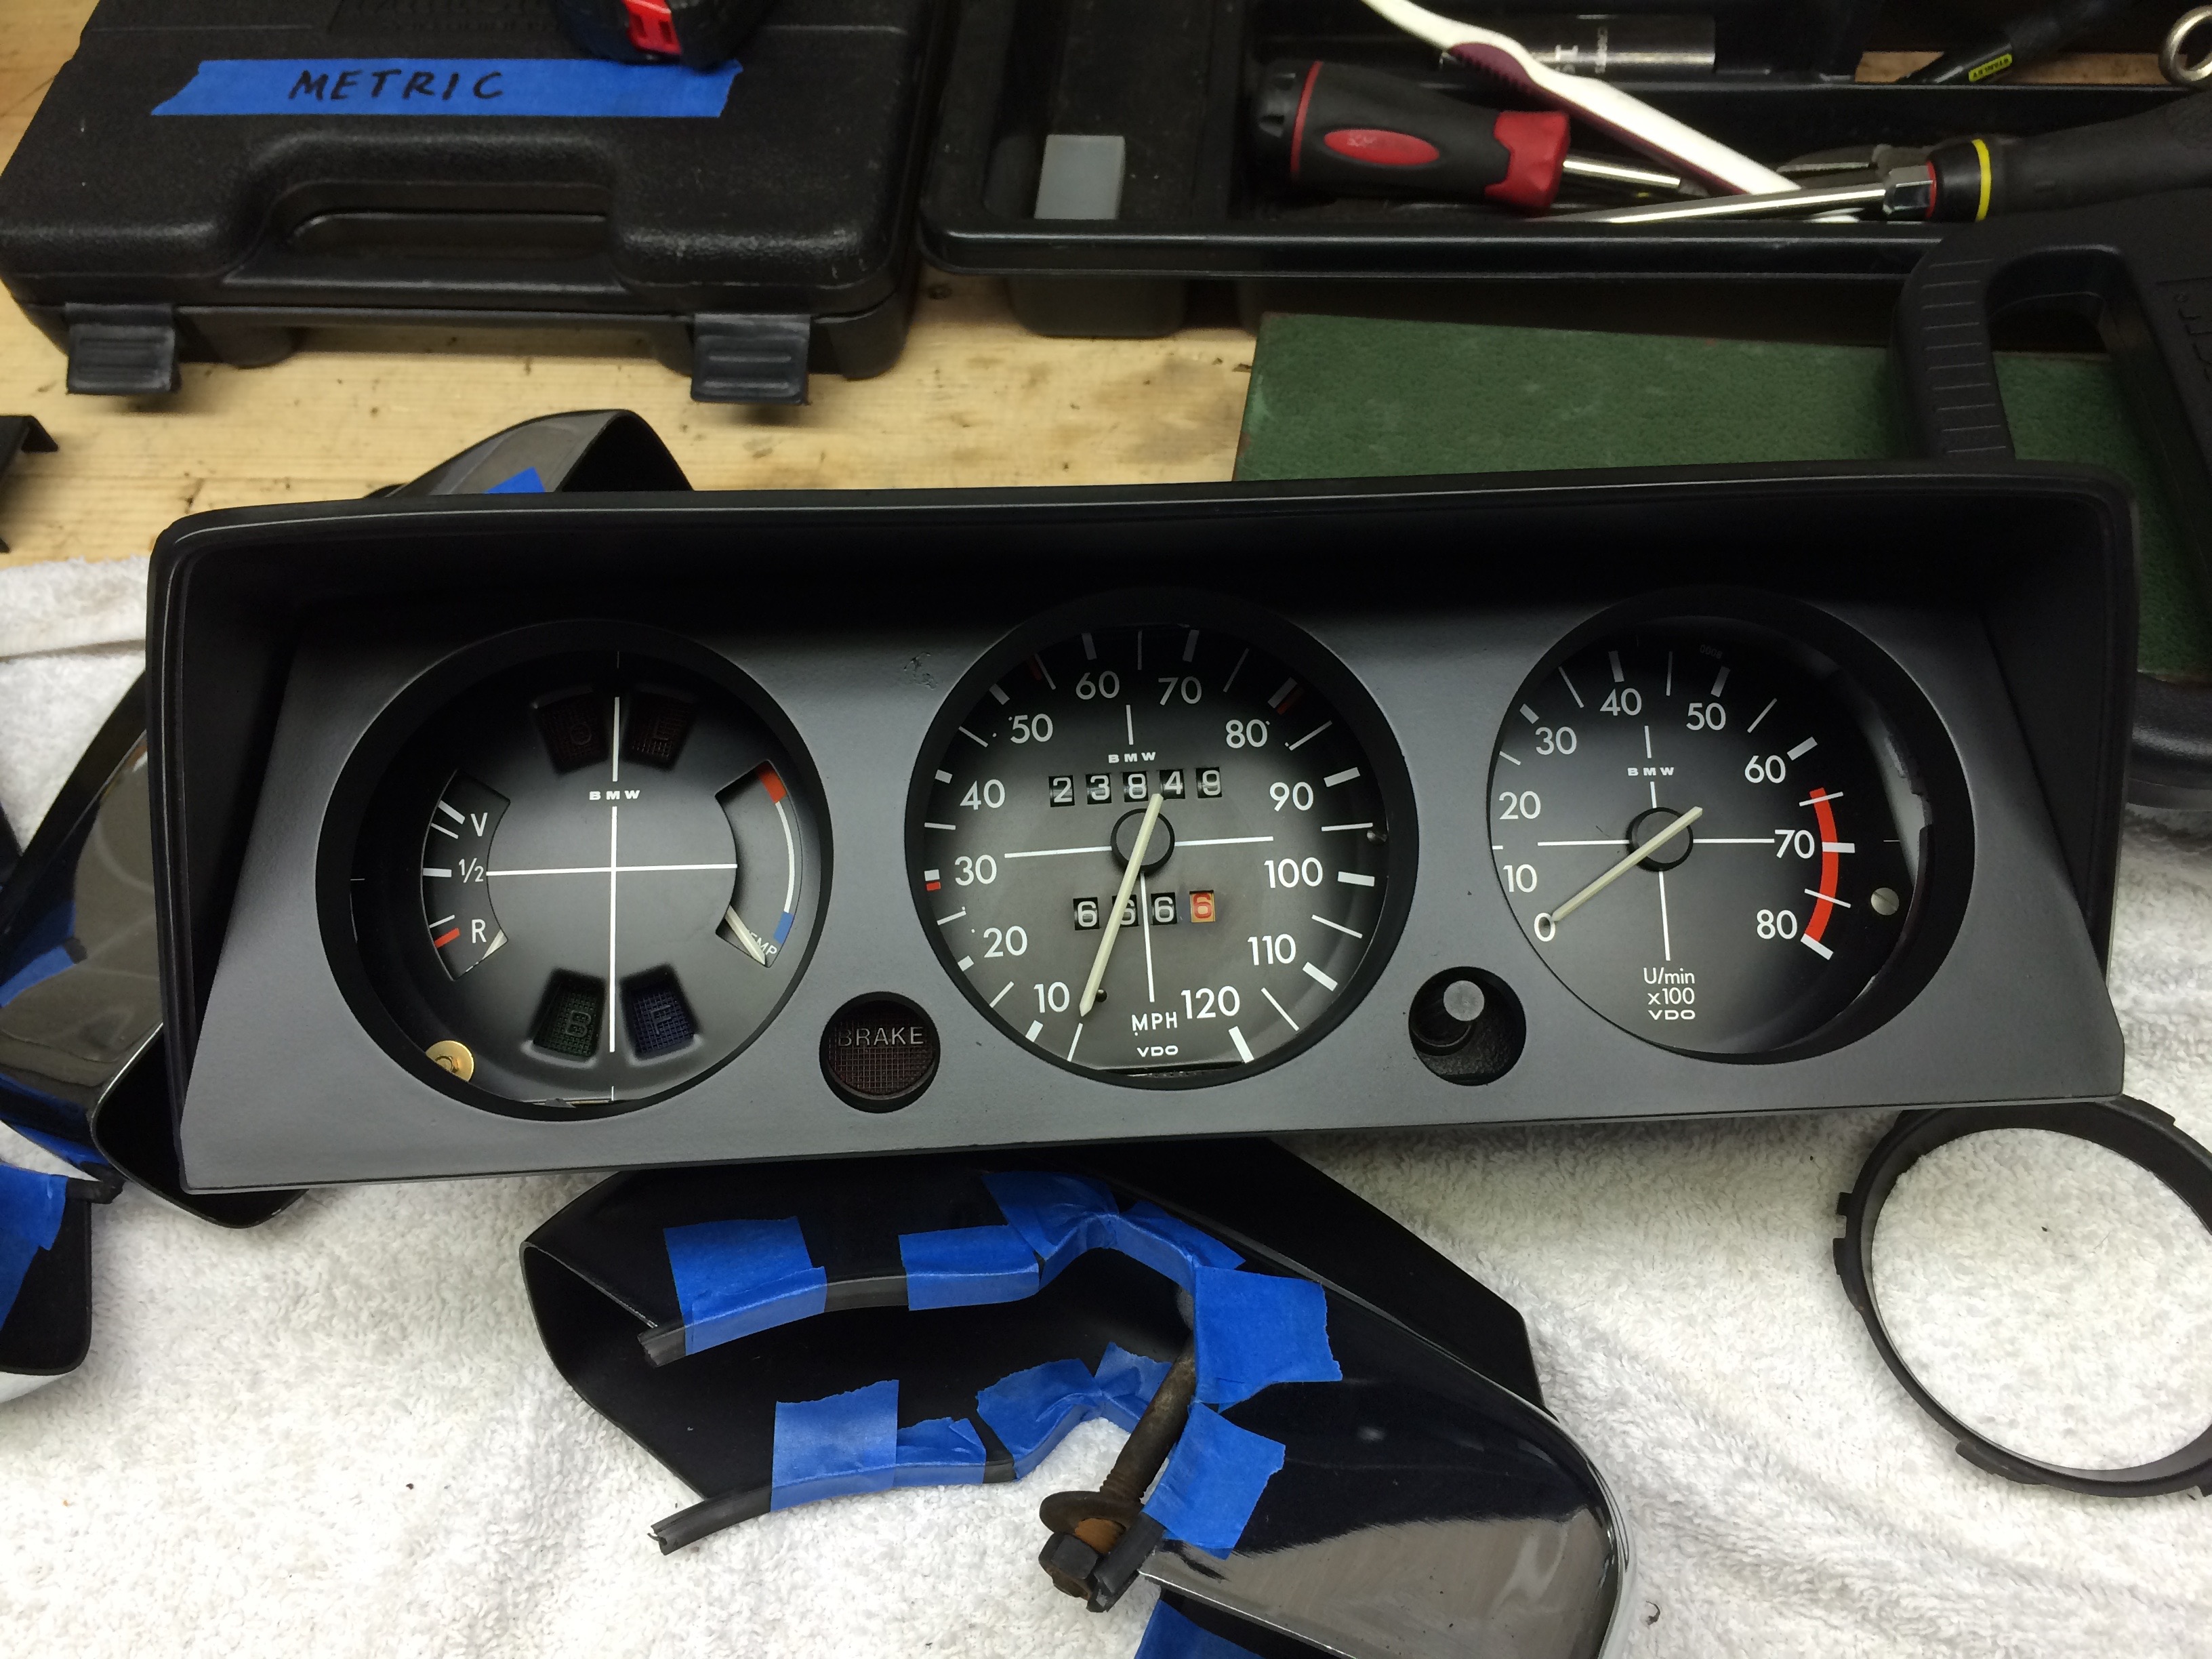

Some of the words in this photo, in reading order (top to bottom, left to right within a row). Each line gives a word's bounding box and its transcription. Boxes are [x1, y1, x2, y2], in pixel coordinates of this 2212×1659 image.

[288, 69, 503, 100] METRIC
[1075, 670, 1120, 700] 60
[1158, 676, 1202, 706] 70
[1599, 689, 1642, 716] 40
[1686, 702, 1726, 731] 50
[1010, 714, 1053, 743] 50
[1225, 719, 1268, 749] 80
[1535, 726, 1577, 756] 30
[1108, 752, 1156, 764] BMW
[1627, 766, 1675, 777] BMW
[1744, 755, 1786, 783] 60
[589, 790, 640, 801] BMW
[960, 779, 1006, 810] 40
[1269, 781, 1314, 812] 90
[1499, 791, 1542, 819] 20
[470, 813, 488, 837] V
[1775, 829, 1815, 859] 70
[954, 855, 998, 886] 30
[1263, 857, 1324, 888] 100
[1502, 865, 1538, 893] 10
[472, 919, 487, 944] R
[1534, 911, 1557, 943] 0
[1757, 909, 1798, 939] 80
[983, 926, 1028, 958] 20
[1247, 933, 1296, 966] 110
[1643, 966, 1696, 985] U/min
[1033, 981, 1070, 1013] 10
[1181, 985, 1240, 1019] 120
[1647, 987, 1696, 1006] x100
[1131, 1011, 1178, 1032] MPH
[1647, 1009, 1696, 1021] VDO
[838, 1025, 924, 1047] BRAKE
[1136, 1044, 1179, 1057] VDO
